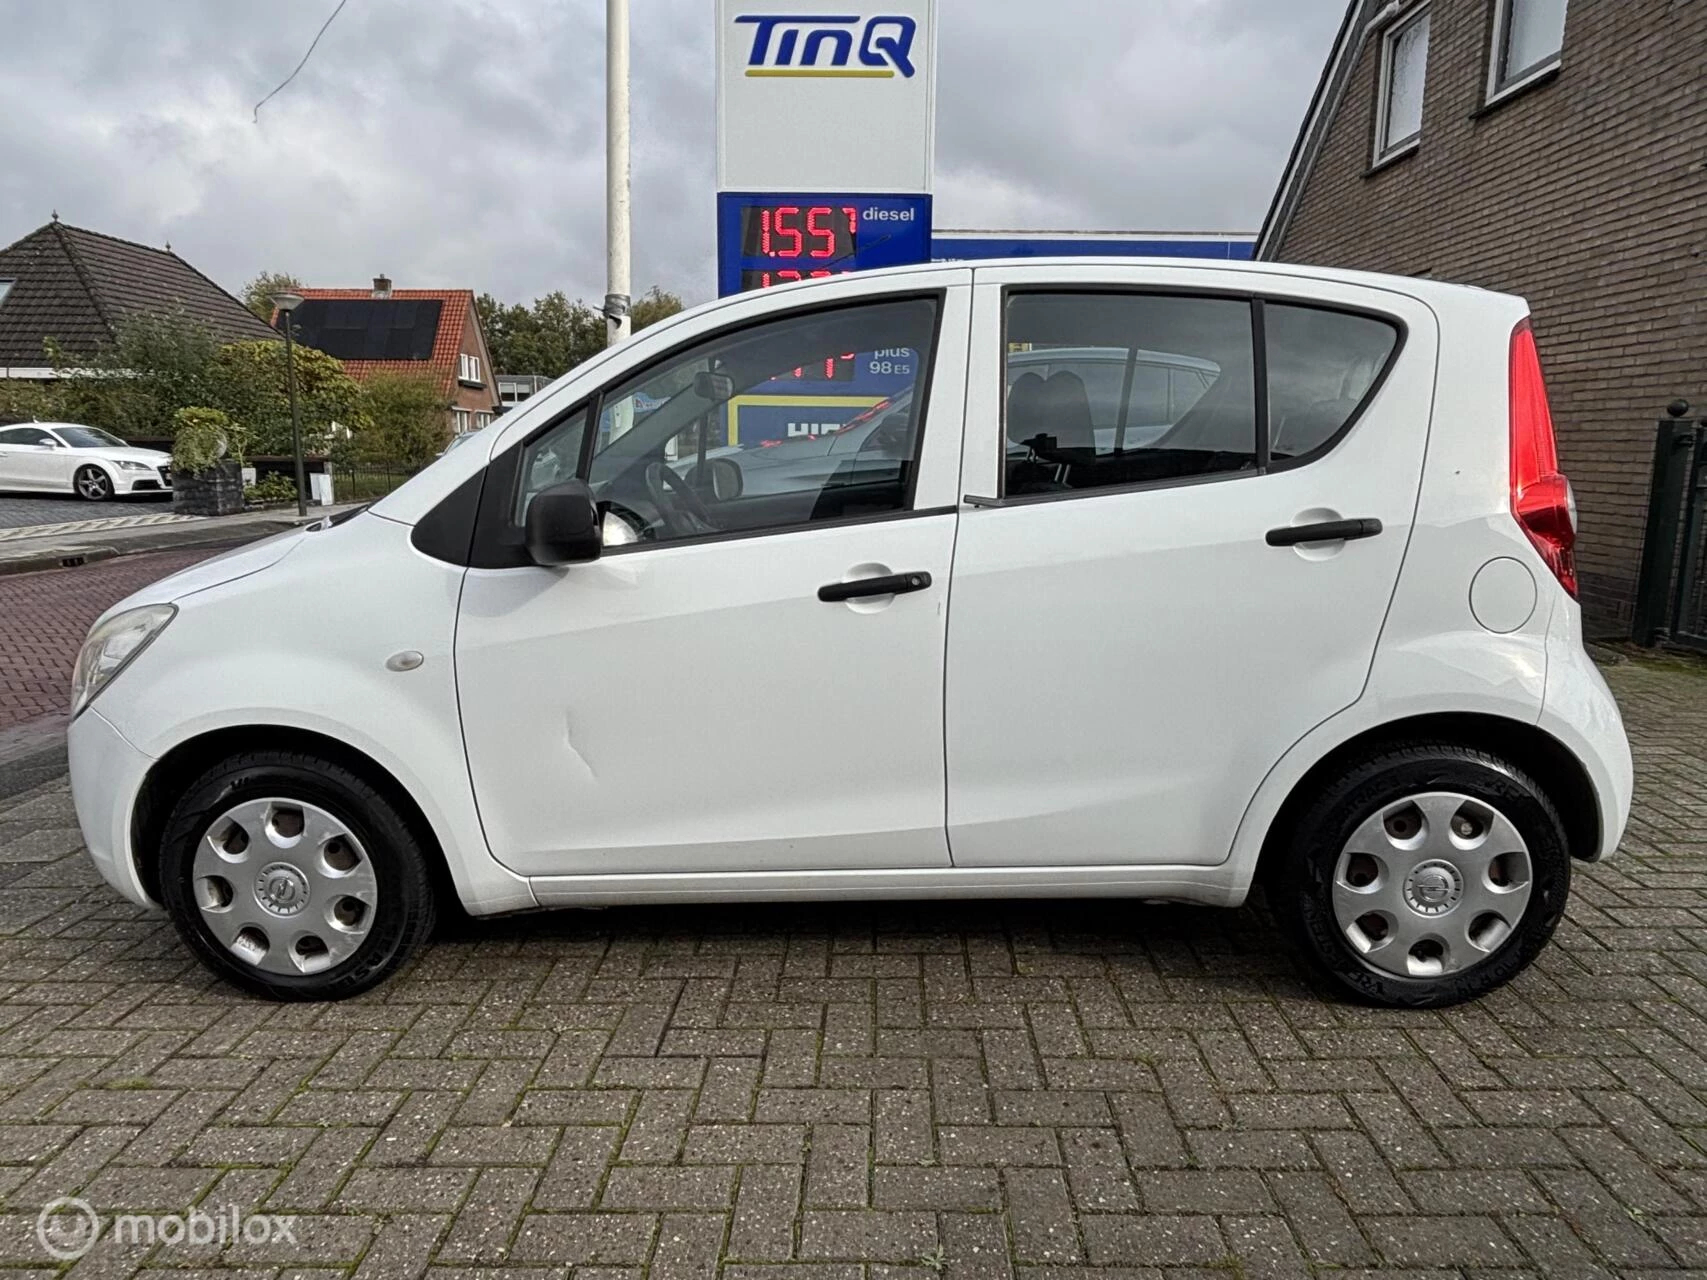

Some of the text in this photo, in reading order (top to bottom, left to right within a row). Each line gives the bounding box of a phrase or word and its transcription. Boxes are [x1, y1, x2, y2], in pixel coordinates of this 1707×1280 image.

[734, 15, 916, 78] TinQ
[862, 207, 915, 221] diesel
[869, 361, 910, 374] 98 E5
